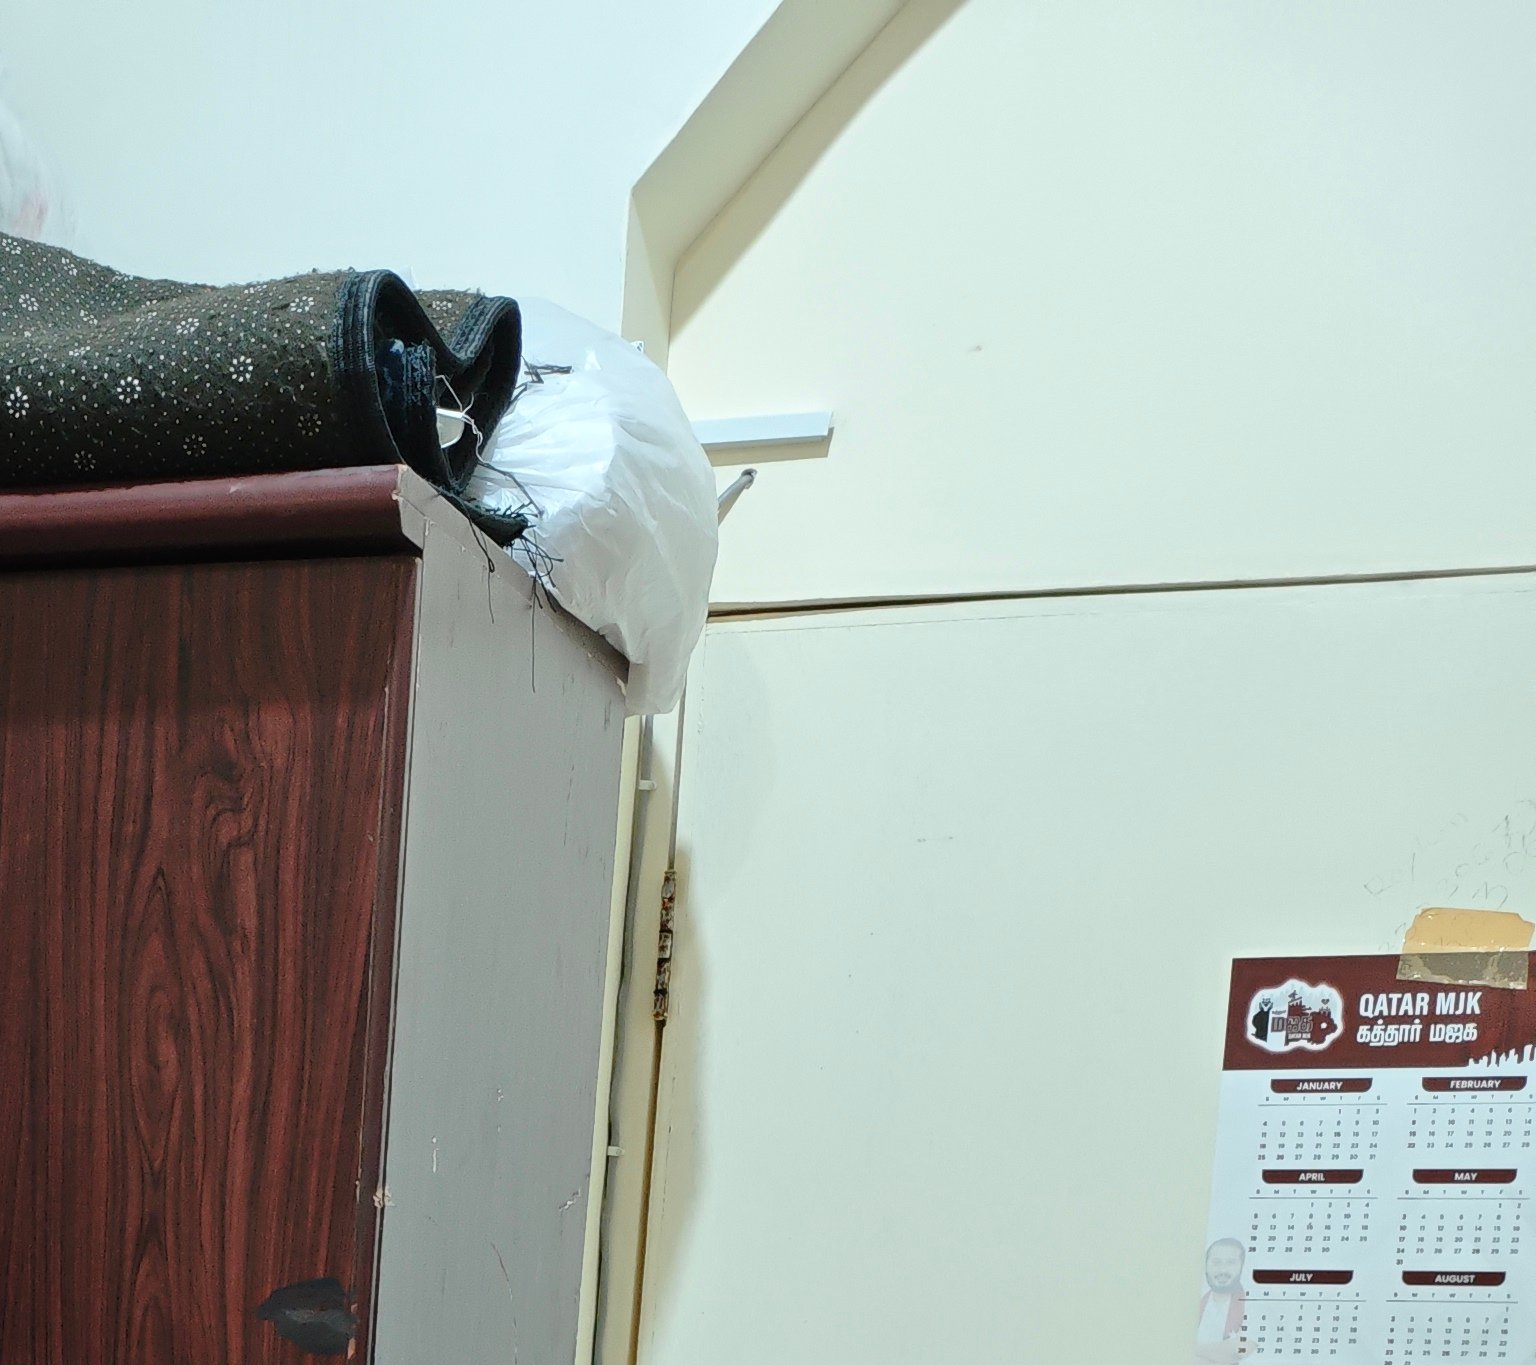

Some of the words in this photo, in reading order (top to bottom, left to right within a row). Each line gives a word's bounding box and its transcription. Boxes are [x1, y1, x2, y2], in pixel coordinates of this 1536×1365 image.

[1359, 992, 1430, 1018] QATAR
[1435, 991, 1483, 1016] MJK
[1356, 1018, 1422, 1047] கத்தார்
[1429, 1022, 1478, 1044] மஜக
[1296, 1081, 1343, 1091] JANUARY
[1450, 1080, 1501, 1089] FEBRUARY
[1298, 1172, 1325, 1181] APRIL
[1454, 1172, 1478, 1181] MAY
[1289, 1273, 1314, 1282] JULY
[1434, 1275, 1476, 1283] AUGUST
